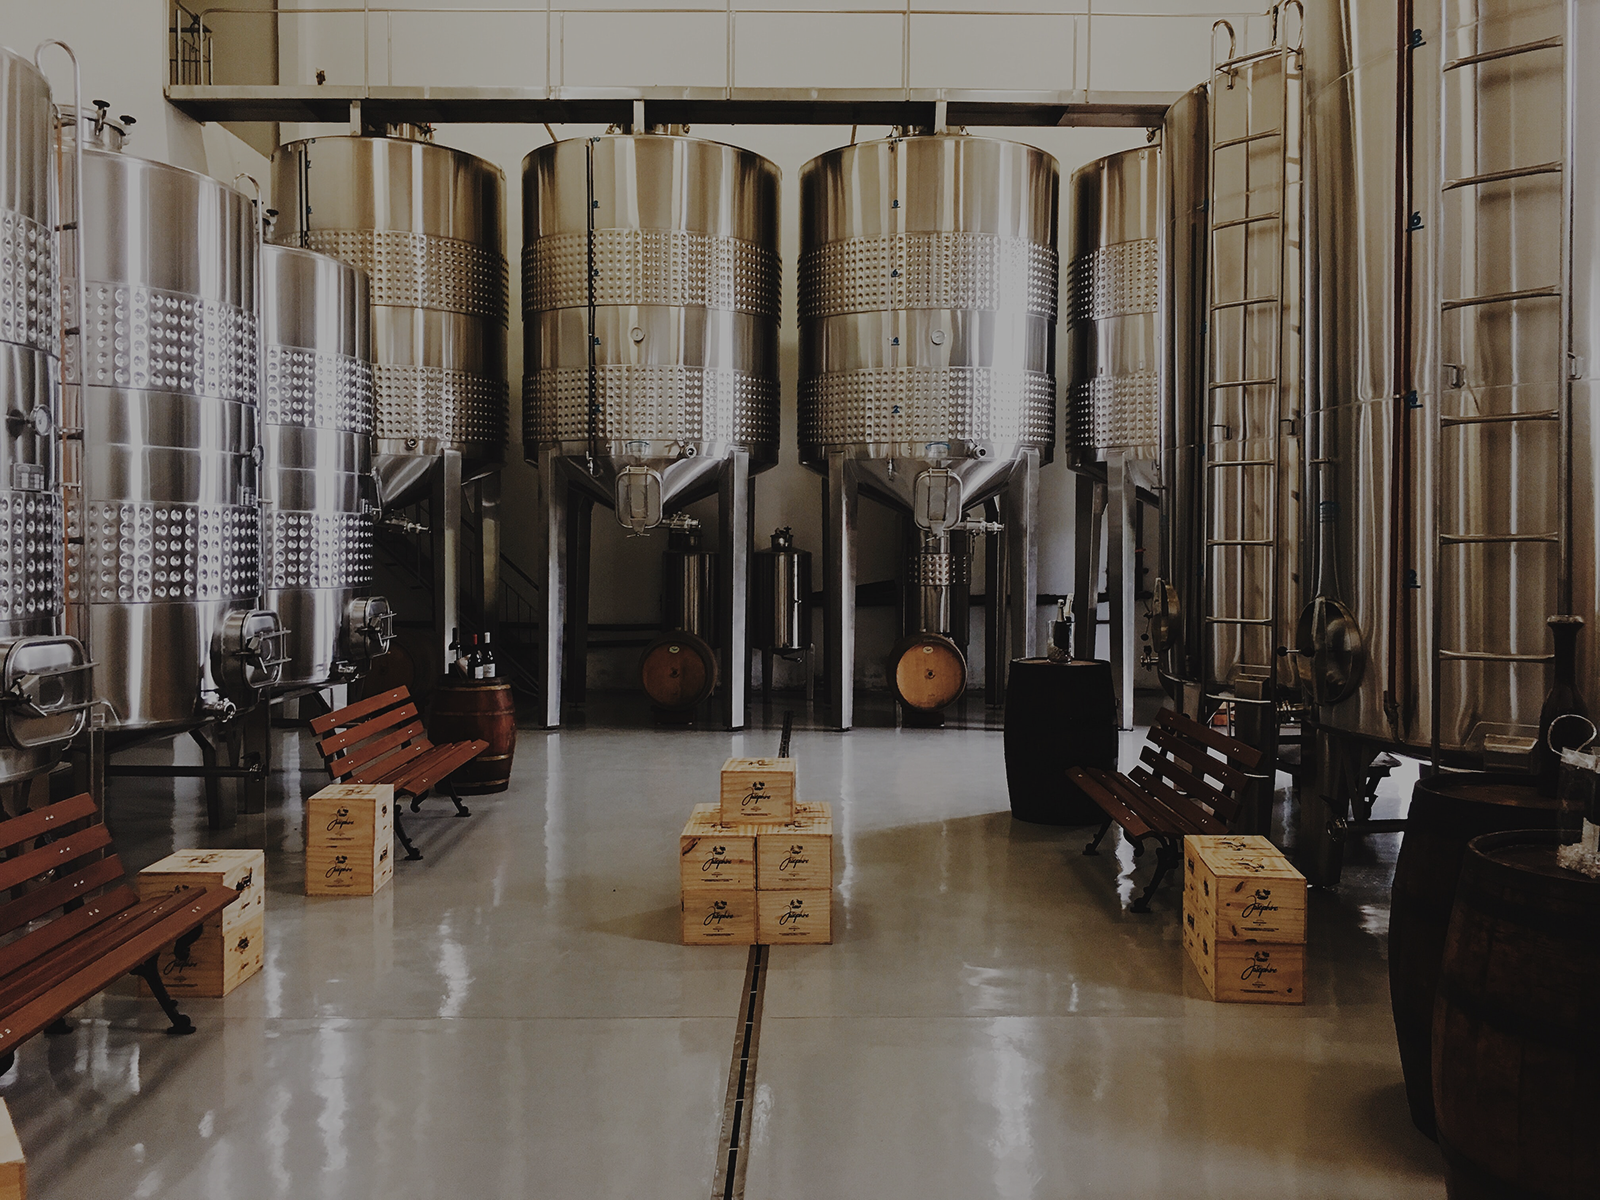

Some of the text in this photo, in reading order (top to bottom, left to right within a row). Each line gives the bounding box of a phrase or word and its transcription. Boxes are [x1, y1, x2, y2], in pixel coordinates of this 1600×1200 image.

[1412, 29, 1422, 44] 8
[1411, 211, 1422, 227] 6
[892, 405, 900, 414] 2
